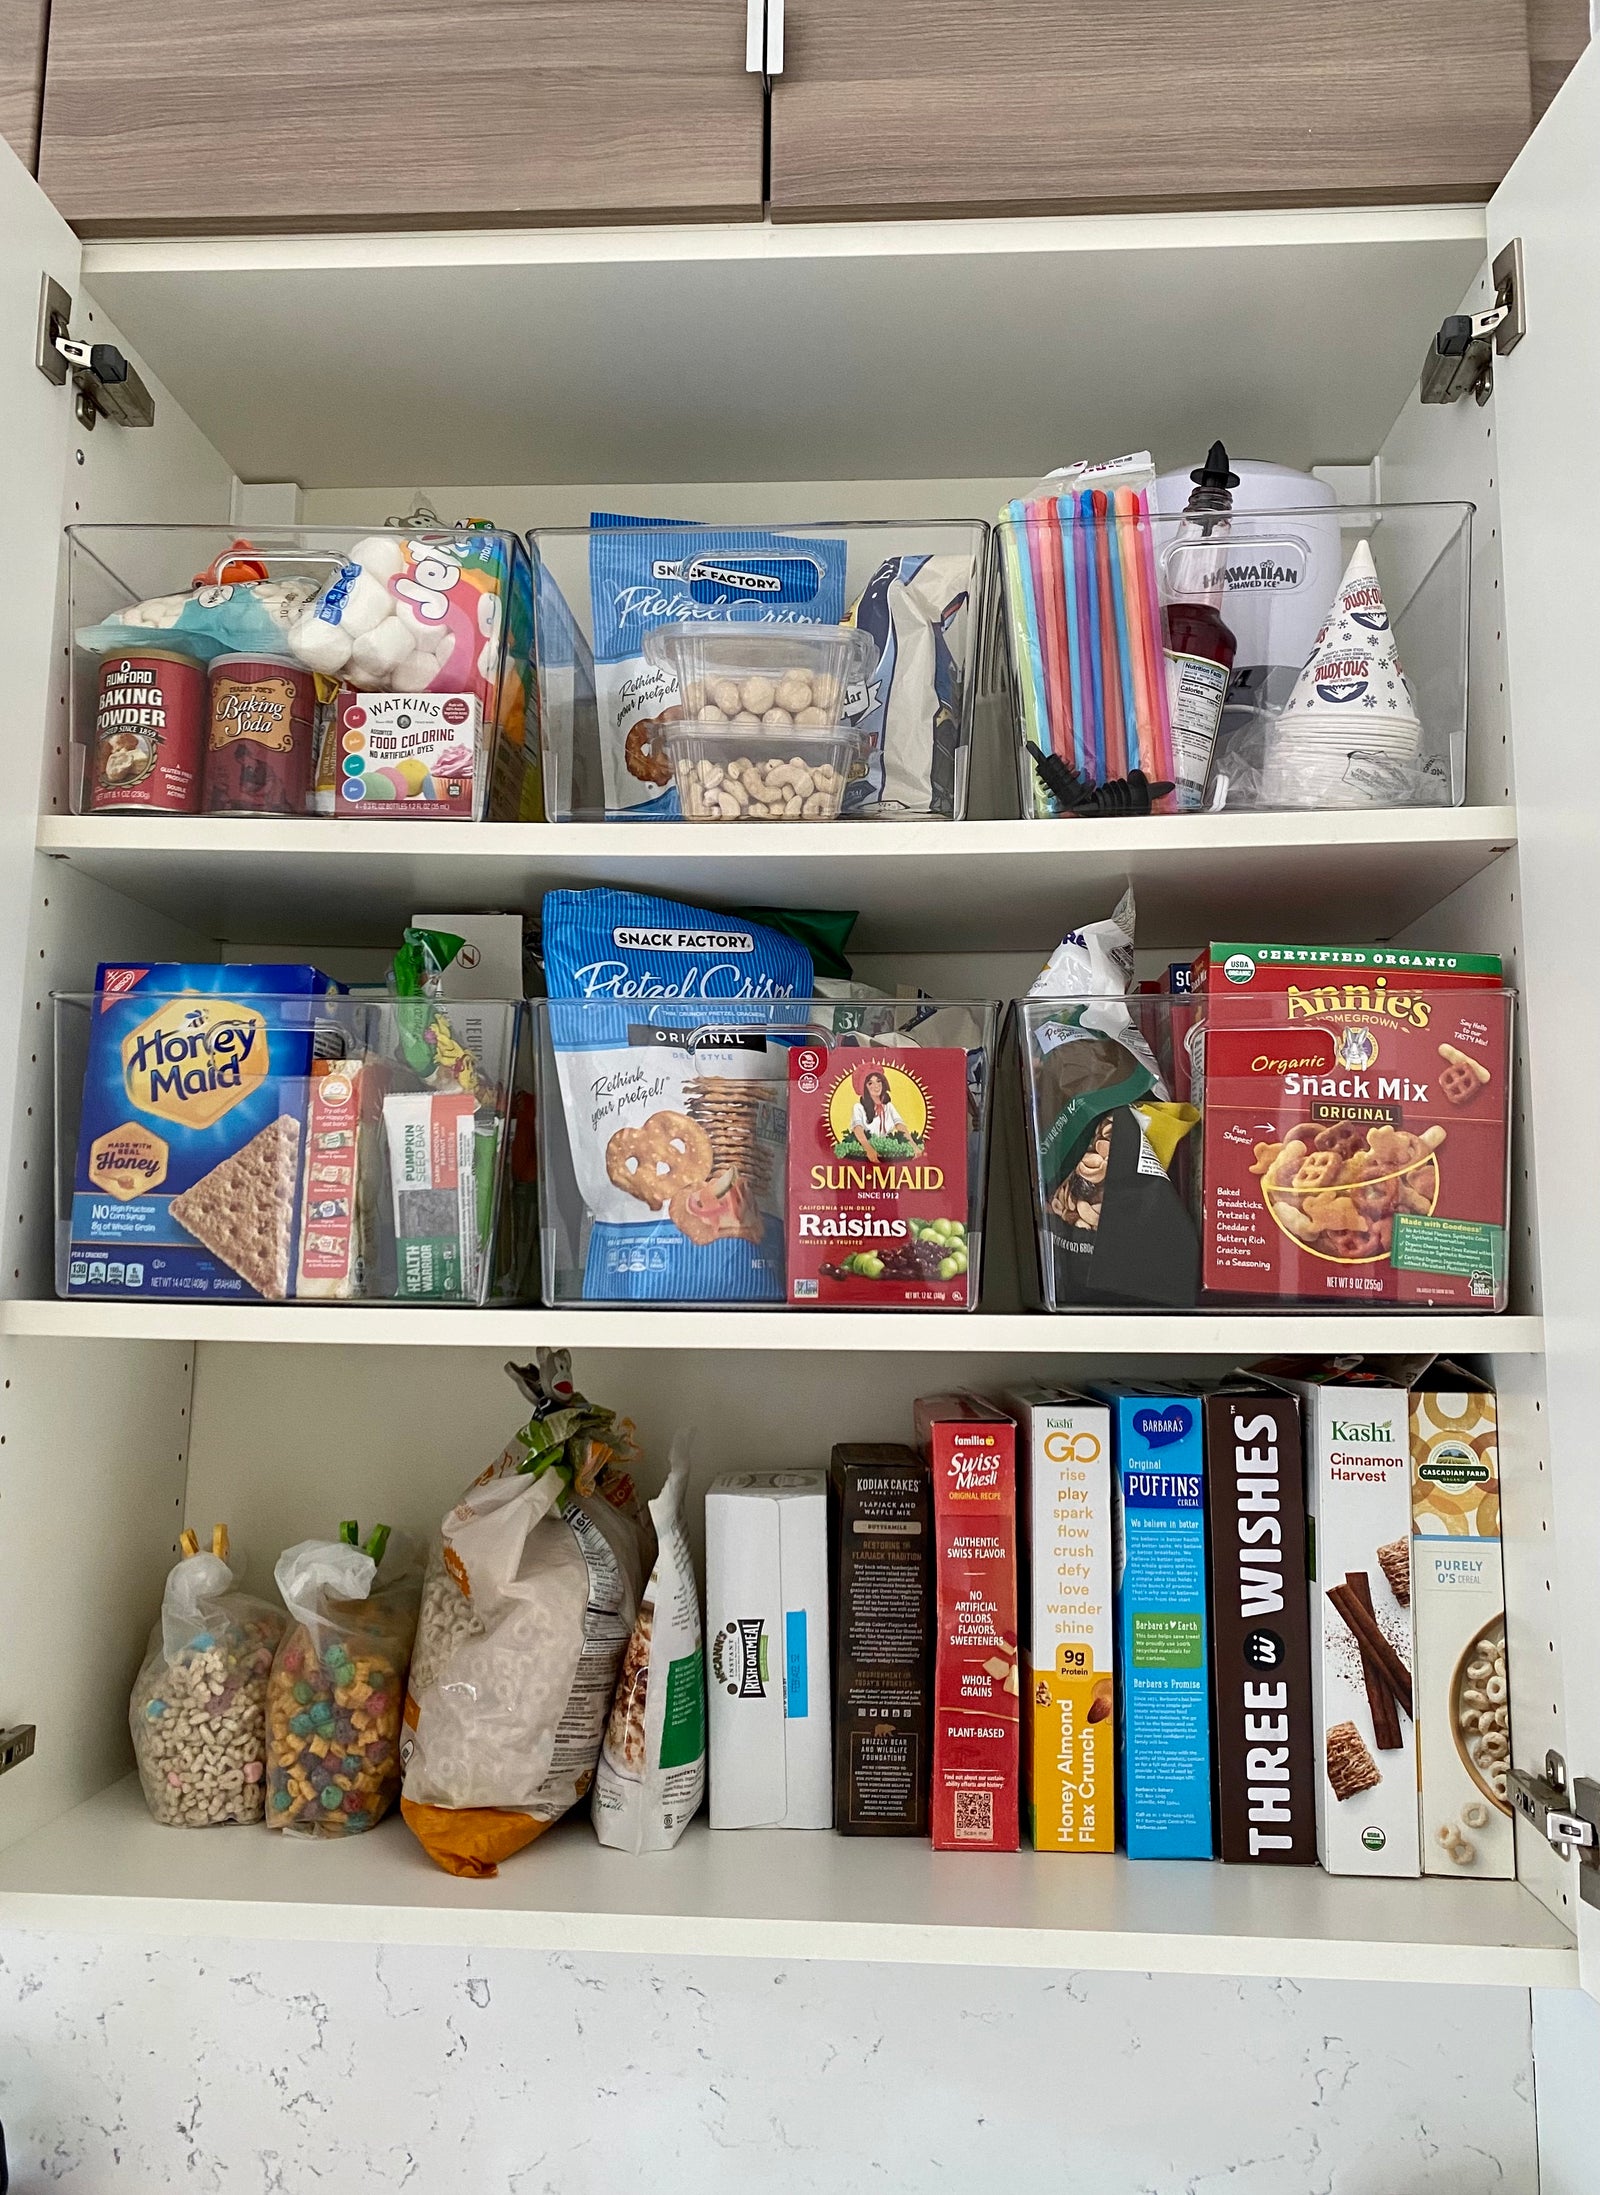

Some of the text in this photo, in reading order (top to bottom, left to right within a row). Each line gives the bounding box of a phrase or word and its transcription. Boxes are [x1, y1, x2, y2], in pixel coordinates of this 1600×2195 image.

[711, 571, 778, 590] FACTORY
[1229, 580, 1277, 591] SHAVED ICE
[1184, 662, 1211, 674] Nutrition
[1314, 660, 1369, 683] Sno-Kone
[106, 671, 153, 687] RUMFORD
[619, 669, 666, 702] Rethink
[1180, 684, 1204, 696] Calories
[99, 688, 164, 711] BAKING
[616, 679, 681, 727] your pretzel!
[215, 694, 285, 721] Baking
[369, 698, 441, 718] WATKINS
[97, 708, 167, 731] POWDER
[225, 711, 274, 737] Soda
[118, 726, 157, 739] SINCE 1859
[369, 728, 455, 750] FOOD COLORING
[369, 744, 434, 760] NO ARTIFICIAL DYES
[618, 932, 748, 948] SNACK FACTORY
[1230, 961, 1249, 969] USDA
[1258, 949, 1458, 968] CERTIFIED ORGANIC
[574, 960, 698, 1021] Pretzel
[1287, 976, 1432, 1029] Annie's
[127, 1019, 257, 1075] Honey
[701, 1053, 734, 1061] STYLE
[1251, 1055, 1326, 1075] Organic
[150, 1054, 242, 1103] Maid
[590, 1066, 649, 1101] Rethink
[1284, 1073, 1429, 1102] Snack Mix
[591, 1077, 665, 1131] your pretzel!
[1319, 1106, 1394, 1122] ORIGINAL
[1232, 1125, 1247, 1135] Fun
[1222, 1132, 1253, 1145] Shapes!
[117, 1148, 141, 1156] REAL
[405, 1124, 415, 1182] PUMPKIN
[416, 1124, 426, 1183] SEED BAR
[96, 1152, 160, 1177] Honey
[882, 1192, 900, 1200] 1912
[1217, 1187, 1240, 1196] Baked
[92, 1204, 155, 1220] NO High Fructose
[1217, 1211, 1249, 1220] Pretzels
[112, 1223, 155, 1232] Whole Grain
[798, 1213, 907, 1237] Raisins
[1216, 1222, 1249, 1232] Cheddar
[1400, 1217, 1482, 1233] Made with Goodness!
[1216, 1234, 1266, 1246] Buttery Rich
[1216, 1245, 1251, 1255] Crackers
[406, 1245, 420, 1293] HEALTH
[420, 1244, 433, 1293] WARRIOR
[1216, 1258, 1271, 1271] in Seasoning
[213, 1279, 242, 1290] GRAHAMS
[1326, 1277, 1363, 1289] NET WT OZ
[1046, 1418, 1073, 1429] Kashi
[1142, 1419, 1184, 1433] BARBARA'S
[1331, 1420, 1392, 1443] Kashi
[954, 1434, 985, 1446] familia
[1043, 1431, 1102, 1463] GO
[947, 1452, 1001, 1476] Swiss
[1128, 1457, 1161, 1471] Original
[1330, 1452, 1404, 1468] Cinnamon
[955, 1470, 998, 1490] Müesli
[1059, 1468, 1087, 1481] rise
[1330, 1468, 1387, 1482] Harvest
[1422, 1469, 1465, 1477] CASCADIAN
[857, 1478, 919, 1493] KODIAK CAKES
[1129, 1475, 1200, 1497] PUFFINS
[948, 1491, 1001, 1500] ORIGINAL RECIPE
[1057, 1487, 1088, 1503] play
[860, 1501, 897, 1509] FLAPJACK
[1177, 1498, 1199, 1507] CEREAL
[1053, 1506, 1094, 1521] spark
[1130, 1518, 1199, 1529] We believe in better
[1057, 1524, 1090, 1538] flow
[953, 1537, 1000, 1547] AUTHENTIC
[852, 1551, 922, 1561] FLAPJACK TRADITION
[947, 1548, 1006, 1559] SWISS FLAVOR
[1053, 1545, 1094, 1557] crush
[1057, 1563, 1091, 1579] defy
[1435, 1560, 1483, 1572] PURELY
[1437, 1573, 1481, 1584] O'S CEREAL
[969, 1590, 983, 1601] NO
[1059, 1582, 1090, 1595] love
[955, 1601, 998, 1612] ARTIFICIAL
[1046, 1601, 1103, 1615] wander
[958, 1613, 993, 1624] COLORS,
[1135, 1620, 1198, 1631] Barbara's Earth
[958, 1624, 997, 1636] FLAVORS,
[1055, 1620, 1094, 1634] shine
[950, 1635, 1004, 1646] SWEETENERS
[1233, 1414, 1293, 1857] THREE WISHES
[742, 1621, 762, 1694] IRISH OATMEAL
[1064, 1649, 1086, 1667] 9g
[1061, 1667, 1089, 1676] Protein
[961, 1675, 992, 1686] WHOLE
[1133, 1678, 1201, 1690] Barbara's Promise
[960, 1686, 992, 1697] GRAINS
[947, 1727, 1005, 1739] PLANT-BASED
[861, 1737, 908, 1746] GRIZZLY BEAR
[876, 1746, 908, 1754] WILDLIFE
[862, 1754, 906, 1762] FOUNDATIONS
[1056, 1699, 1078, 1843] Honey Almond
[1078, 1727, 1096, 1843] Flax Crunch
